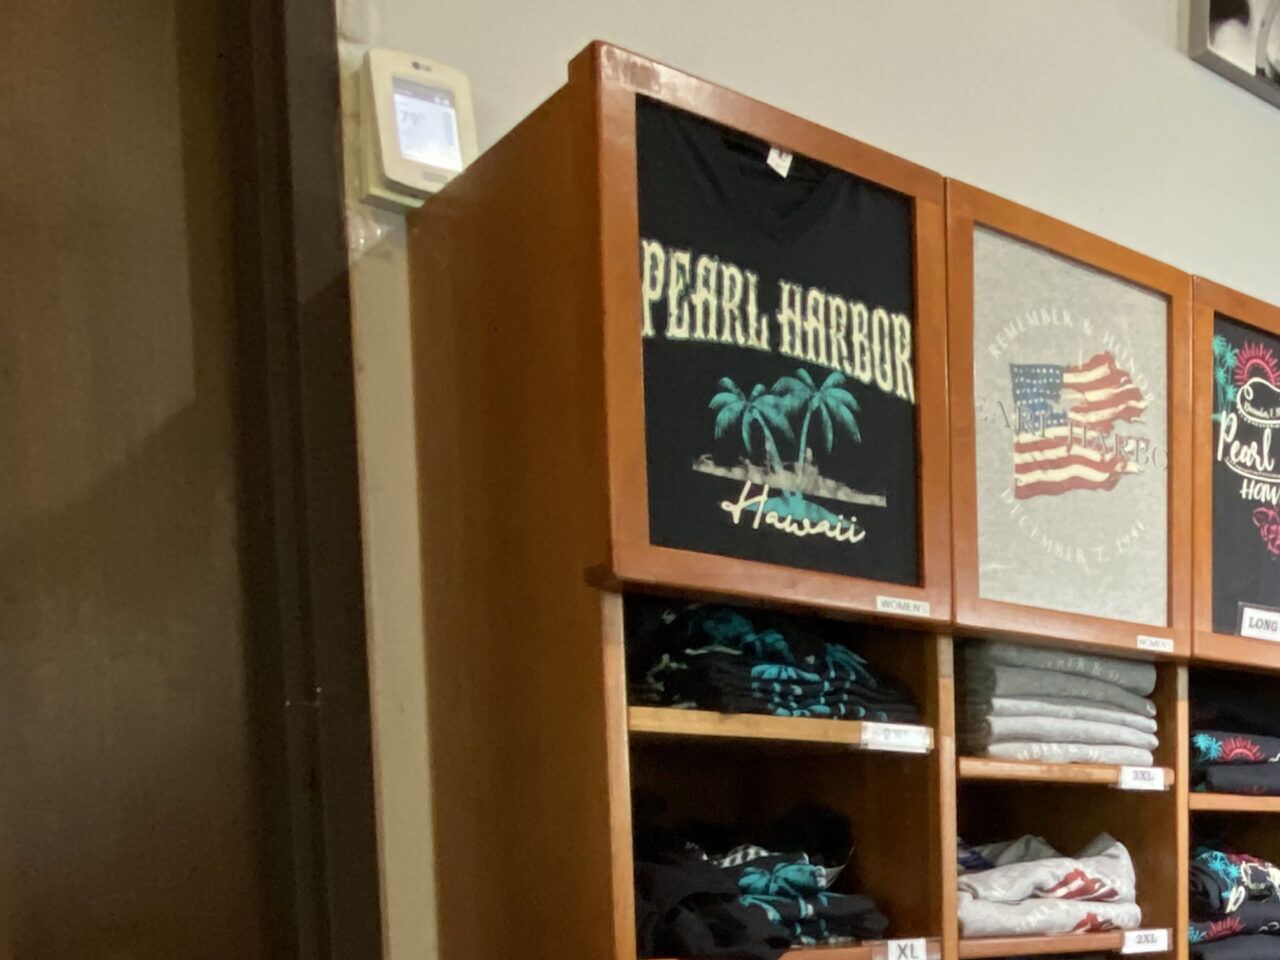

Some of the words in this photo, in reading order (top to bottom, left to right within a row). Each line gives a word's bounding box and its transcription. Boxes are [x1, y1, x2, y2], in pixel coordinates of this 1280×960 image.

[642, 239, 771, 351] PEARL
[777, 279, 915, 404] HARBOR
[987, 307, 1073, 359] REMEMBER
[1217, 410, 1275, 472] Pearl
[720, 480, 866, 544] Hawaii
[1247, 616, 1278, 635] LONG
[1132, 769, 1154, 782] 3XL
[896, 944, 920, 960] XL
[1135, 933, 1158, 945] 2XL
